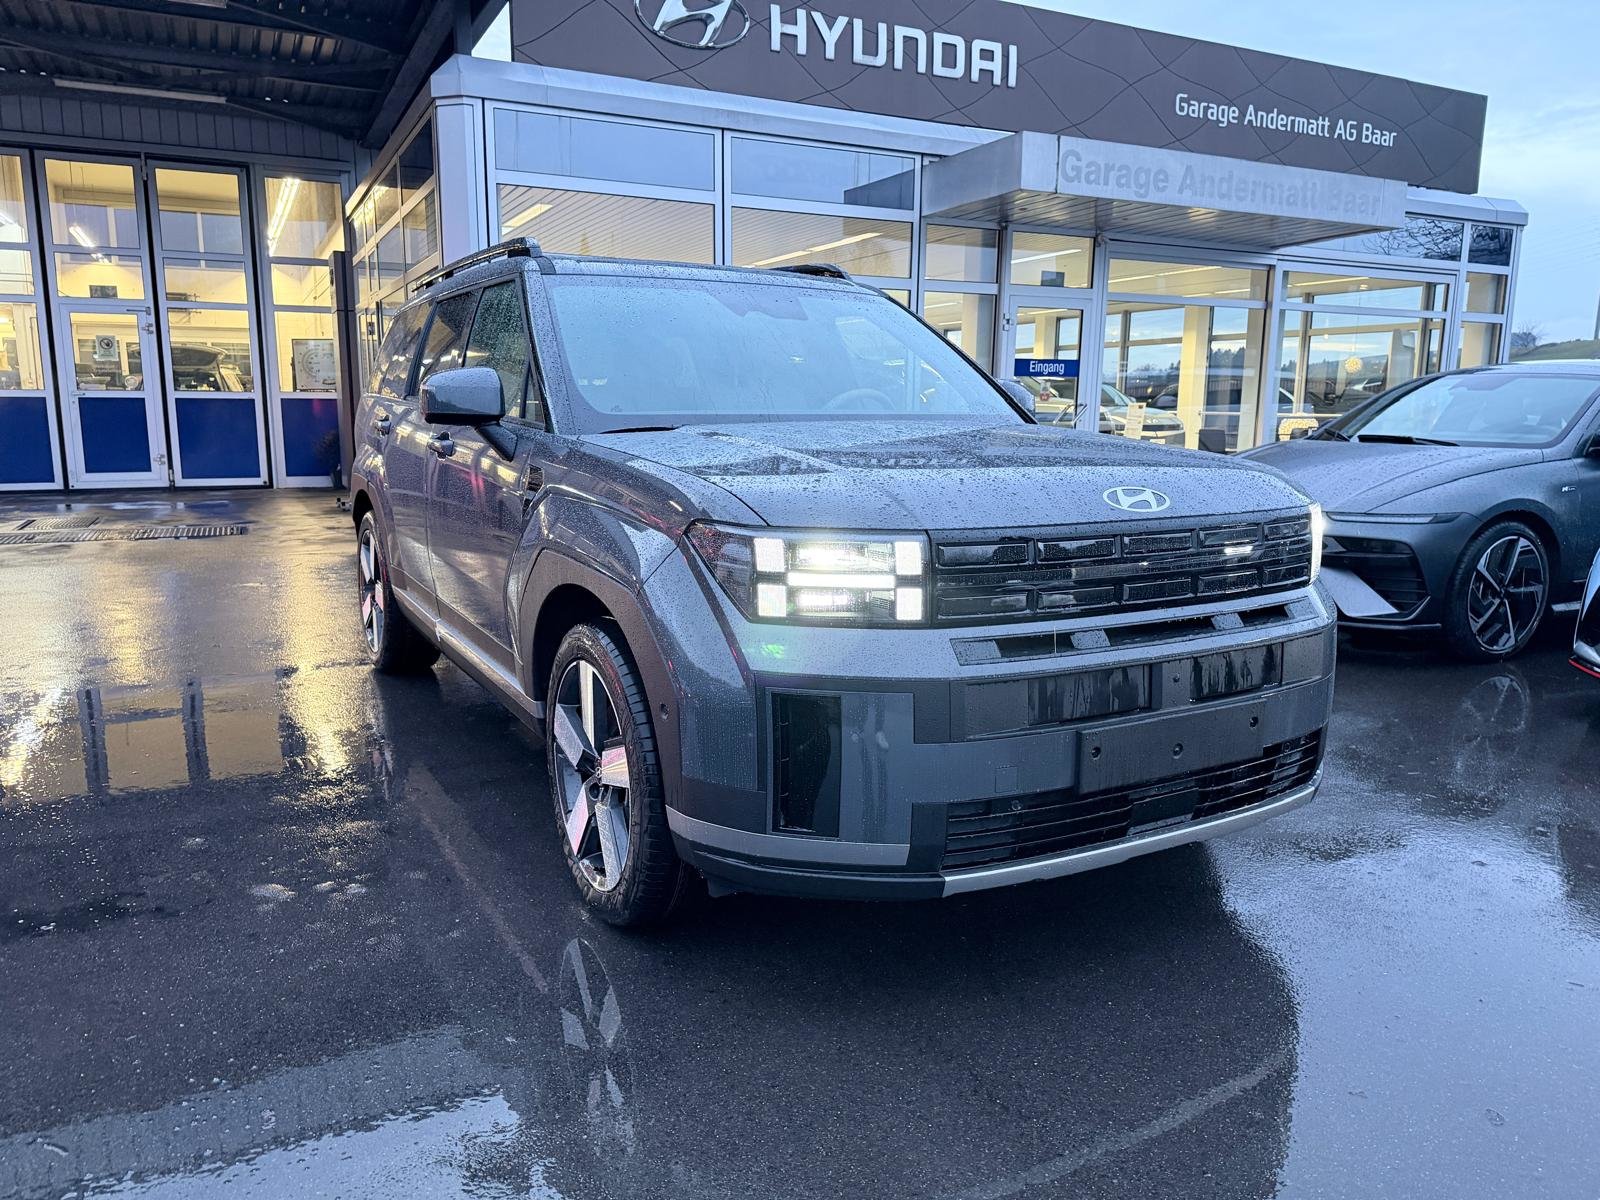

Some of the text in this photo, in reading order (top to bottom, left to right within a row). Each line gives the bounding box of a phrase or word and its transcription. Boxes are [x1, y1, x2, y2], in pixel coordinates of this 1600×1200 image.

[770, 3, 1018, 88] HYUNDAI
[1175, 93, 1397, 147] Garage Andermatt AG Baar
[1060, 148, 1169, 199] Garage
[1177, 164, 1318, 210] Andermatt
[1029, 360, 1065, 375] Eingang
